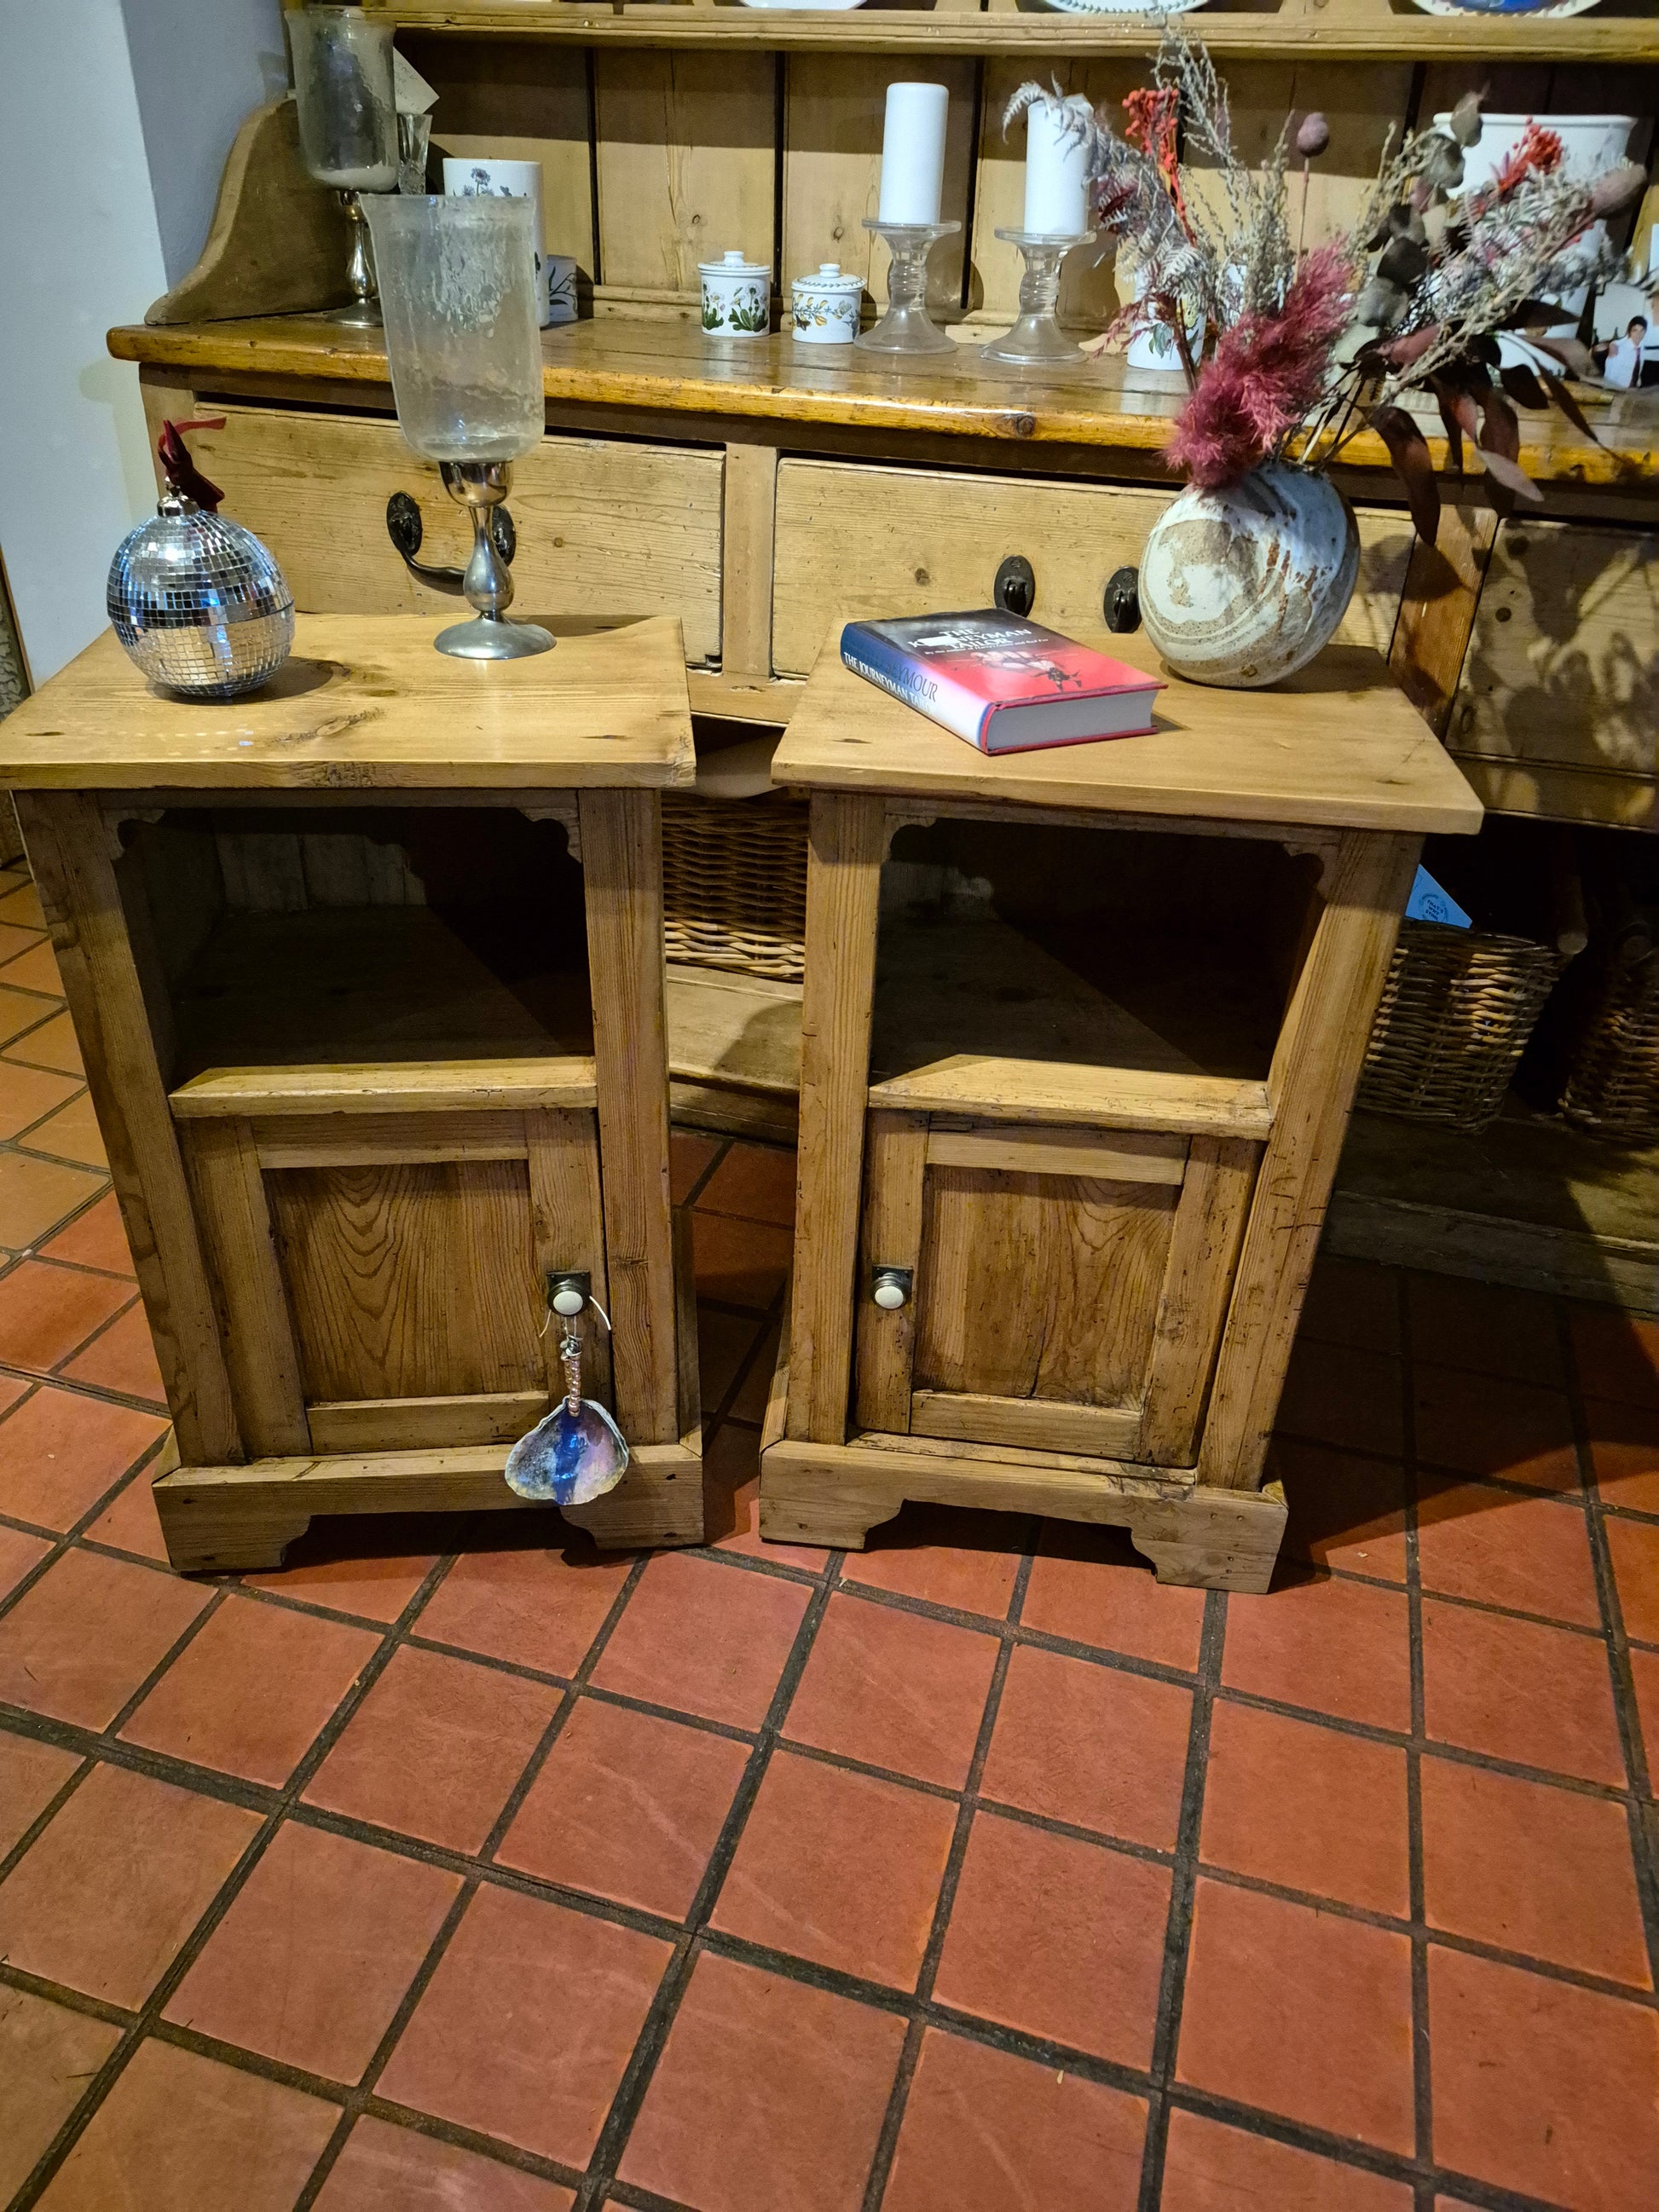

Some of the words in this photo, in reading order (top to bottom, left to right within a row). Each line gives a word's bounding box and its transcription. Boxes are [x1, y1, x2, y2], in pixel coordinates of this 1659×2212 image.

[939, 628, 980, 638] THE
[946, 638, 1012, 649] TAILOR
[843, 651, 859, 670] THE
[859, 661, 908, 701] JOURNEYMAN
[885, 662, 938, 702] SEYMOUR
